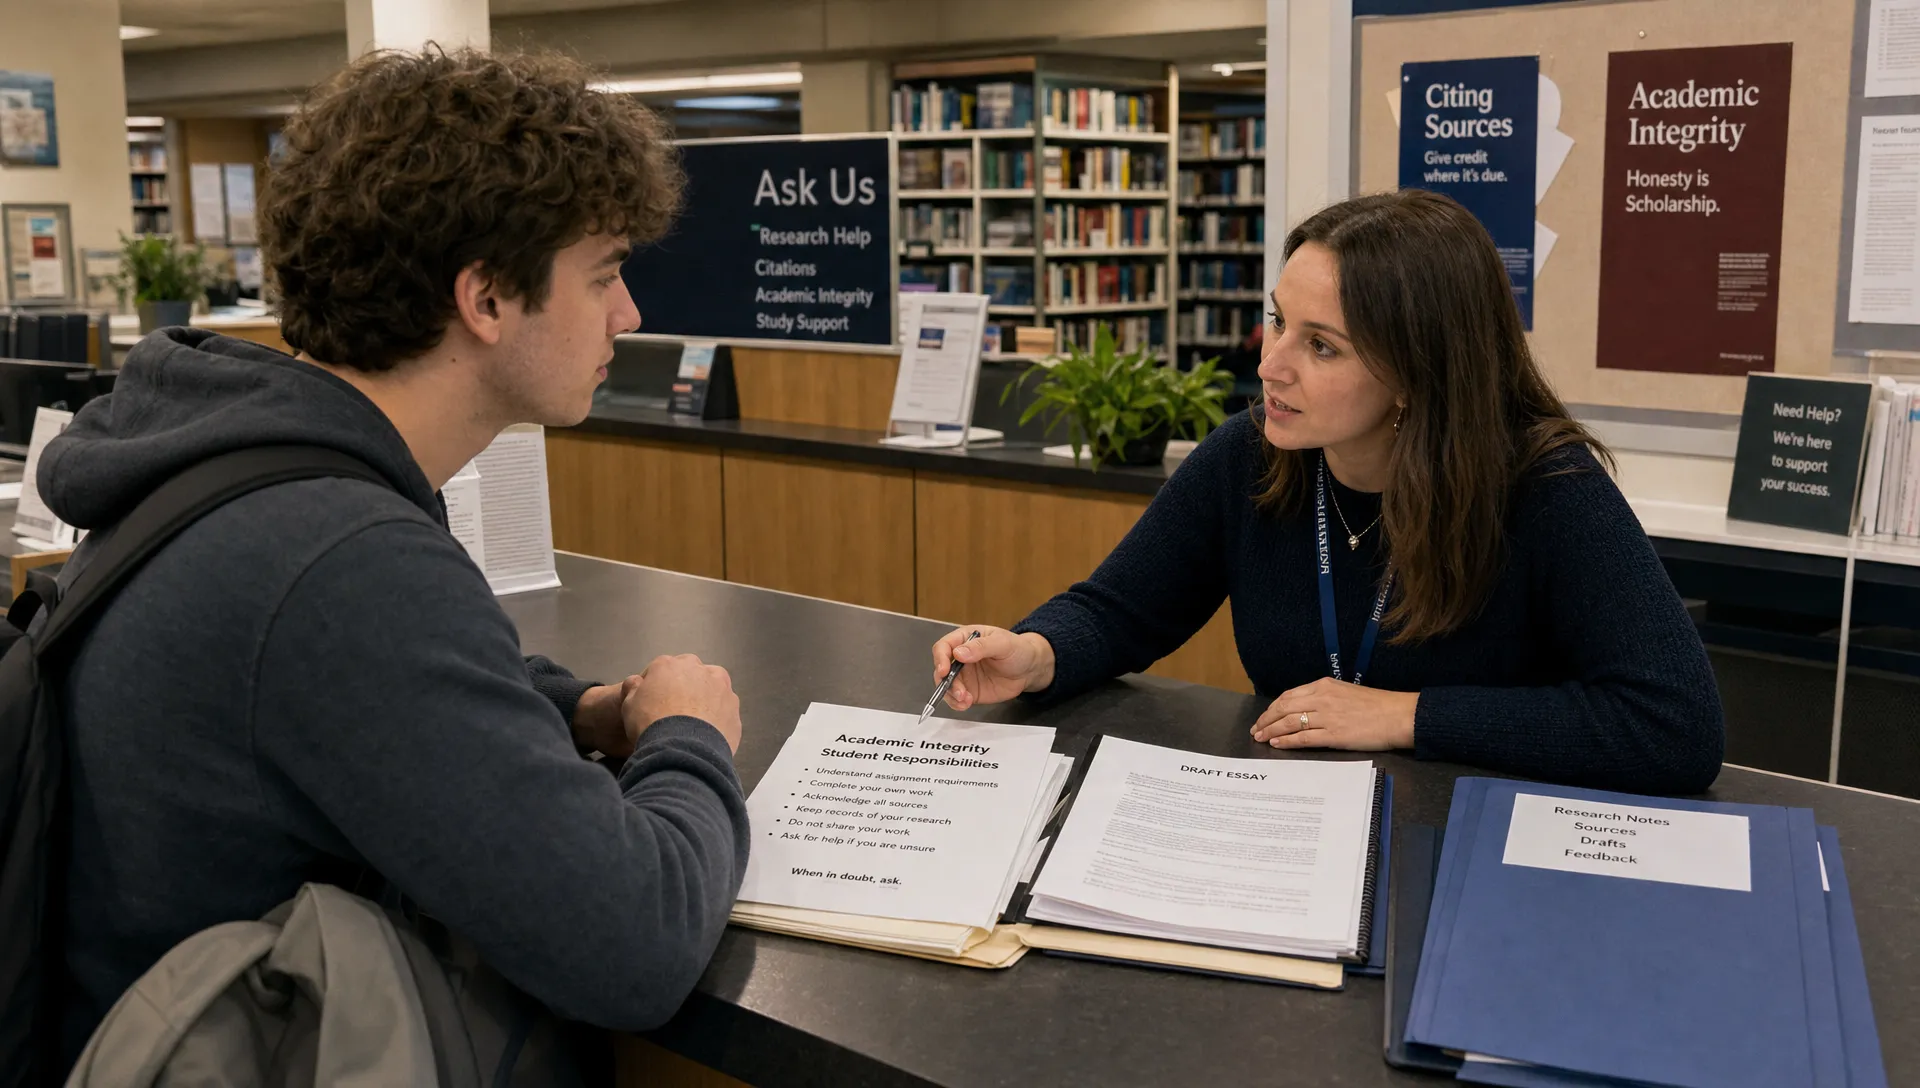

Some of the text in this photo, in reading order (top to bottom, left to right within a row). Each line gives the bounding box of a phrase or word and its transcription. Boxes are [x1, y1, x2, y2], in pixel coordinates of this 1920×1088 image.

[1425, 83, 1493, 113] Citing
[1628, 79, 1760, 109] Academic
[1424, 114, 1513, 139] Sources
[1628, 115, 1746, 153] Integrity
[1424, 149, 1488, 165] Give credit
[1423, 168, 1507, 182] where it's due.
[1626, 169, 1709, 191] Honesty is
[753, 167, 876, 206] Ask Us
[1625, 194, 1720, 217] Scholarship.
[760, 226, 871, 249] Research Help
[755, 259, 817, 276] Citations
[755, 286, 874, 308] Academic Integrity
[756, 312, 849, 334] Study Support
[1773, 402, 1841, 424] Need Help?
[1773, 430, 1832, 450] We're here
[1772, 454, 1828, 474] to support
[1760, 478, 1830, 496] your success.
[835, 734, 990, 755] Academic Integrity
[821, 747, 999, 769] Student Responsibilities
[816, 767, 998, 788] Understand assignment requirements
[1180, 765, 1267, 781] DRAFT ESSAY
[810, 779, 857, 790] Complete
[859, 785, 881, 793] your
[909, 788, 933, 796] work
[802, 792, 928, 809] Acknowledge all sources
[796, 805, 822, 814] Keep
[825, 808, 863, 818] records
[907, 816, 951, 825] research
[1554, 806, 1670, 826] Research Notes
[788, 818, 910, 836] Do not share your work
[1574, 822, 1636, 836] Sources
[780, 832, 800, 840] Ask
[803, 833, 818, 842] for
[821, 835, 844, 845] help
[846, 837, 855, 845] if
[856, 840, 876, 848] you
[900, 843, 935, 852] unsure
[1580, 836, 1626, 849] Drafts
[1564, 849, 1638, 864] Feedback
[791, 867, 902, 885] When in doubt, ask.
